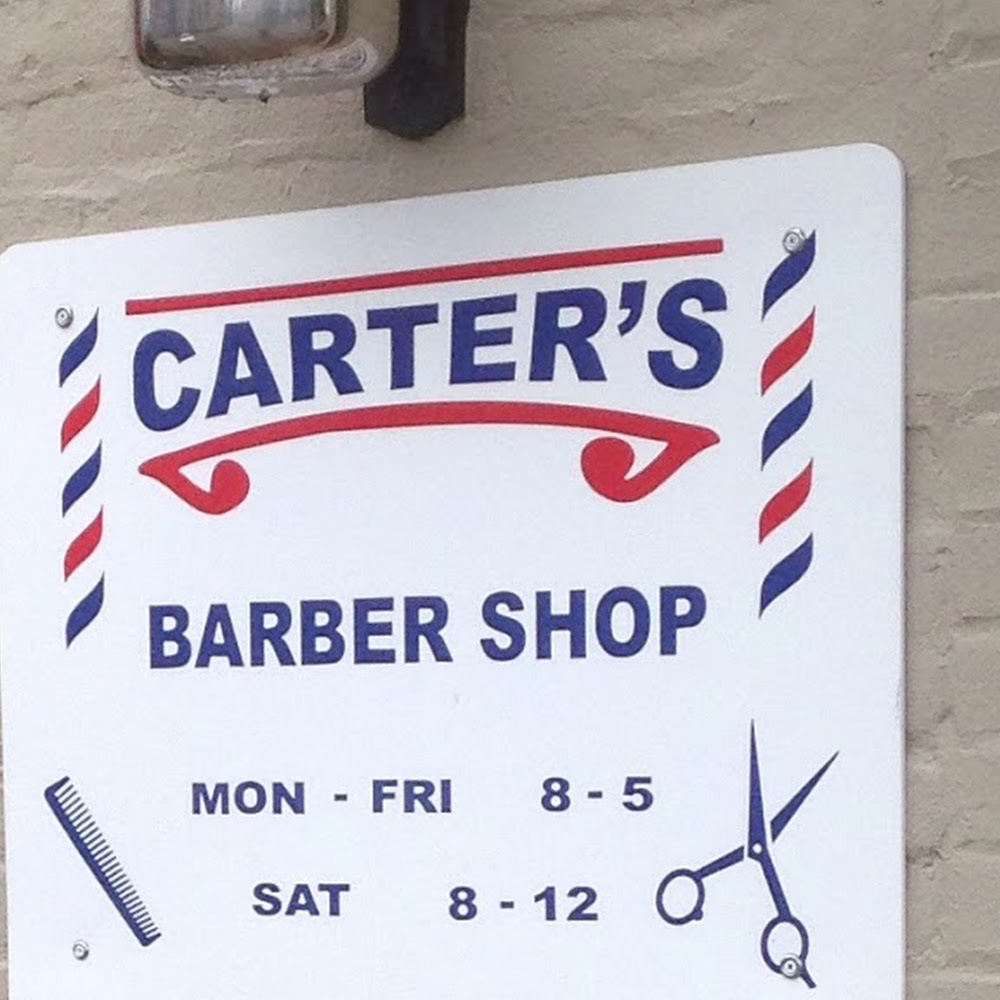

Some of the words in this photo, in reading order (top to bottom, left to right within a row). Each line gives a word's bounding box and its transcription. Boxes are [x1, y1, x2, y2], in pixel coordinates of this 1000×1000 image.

[133, 277, 728, 432] CARTER'S
[149, 595, 454, 670] BARBER
[479, 585, 707, 662] SHOP
[191, 780, 305, 815] MON
[372, 779, 452, 814] FRI
[252, 882, 350, 917] SAT
[533, 886, 599, 922] 12
